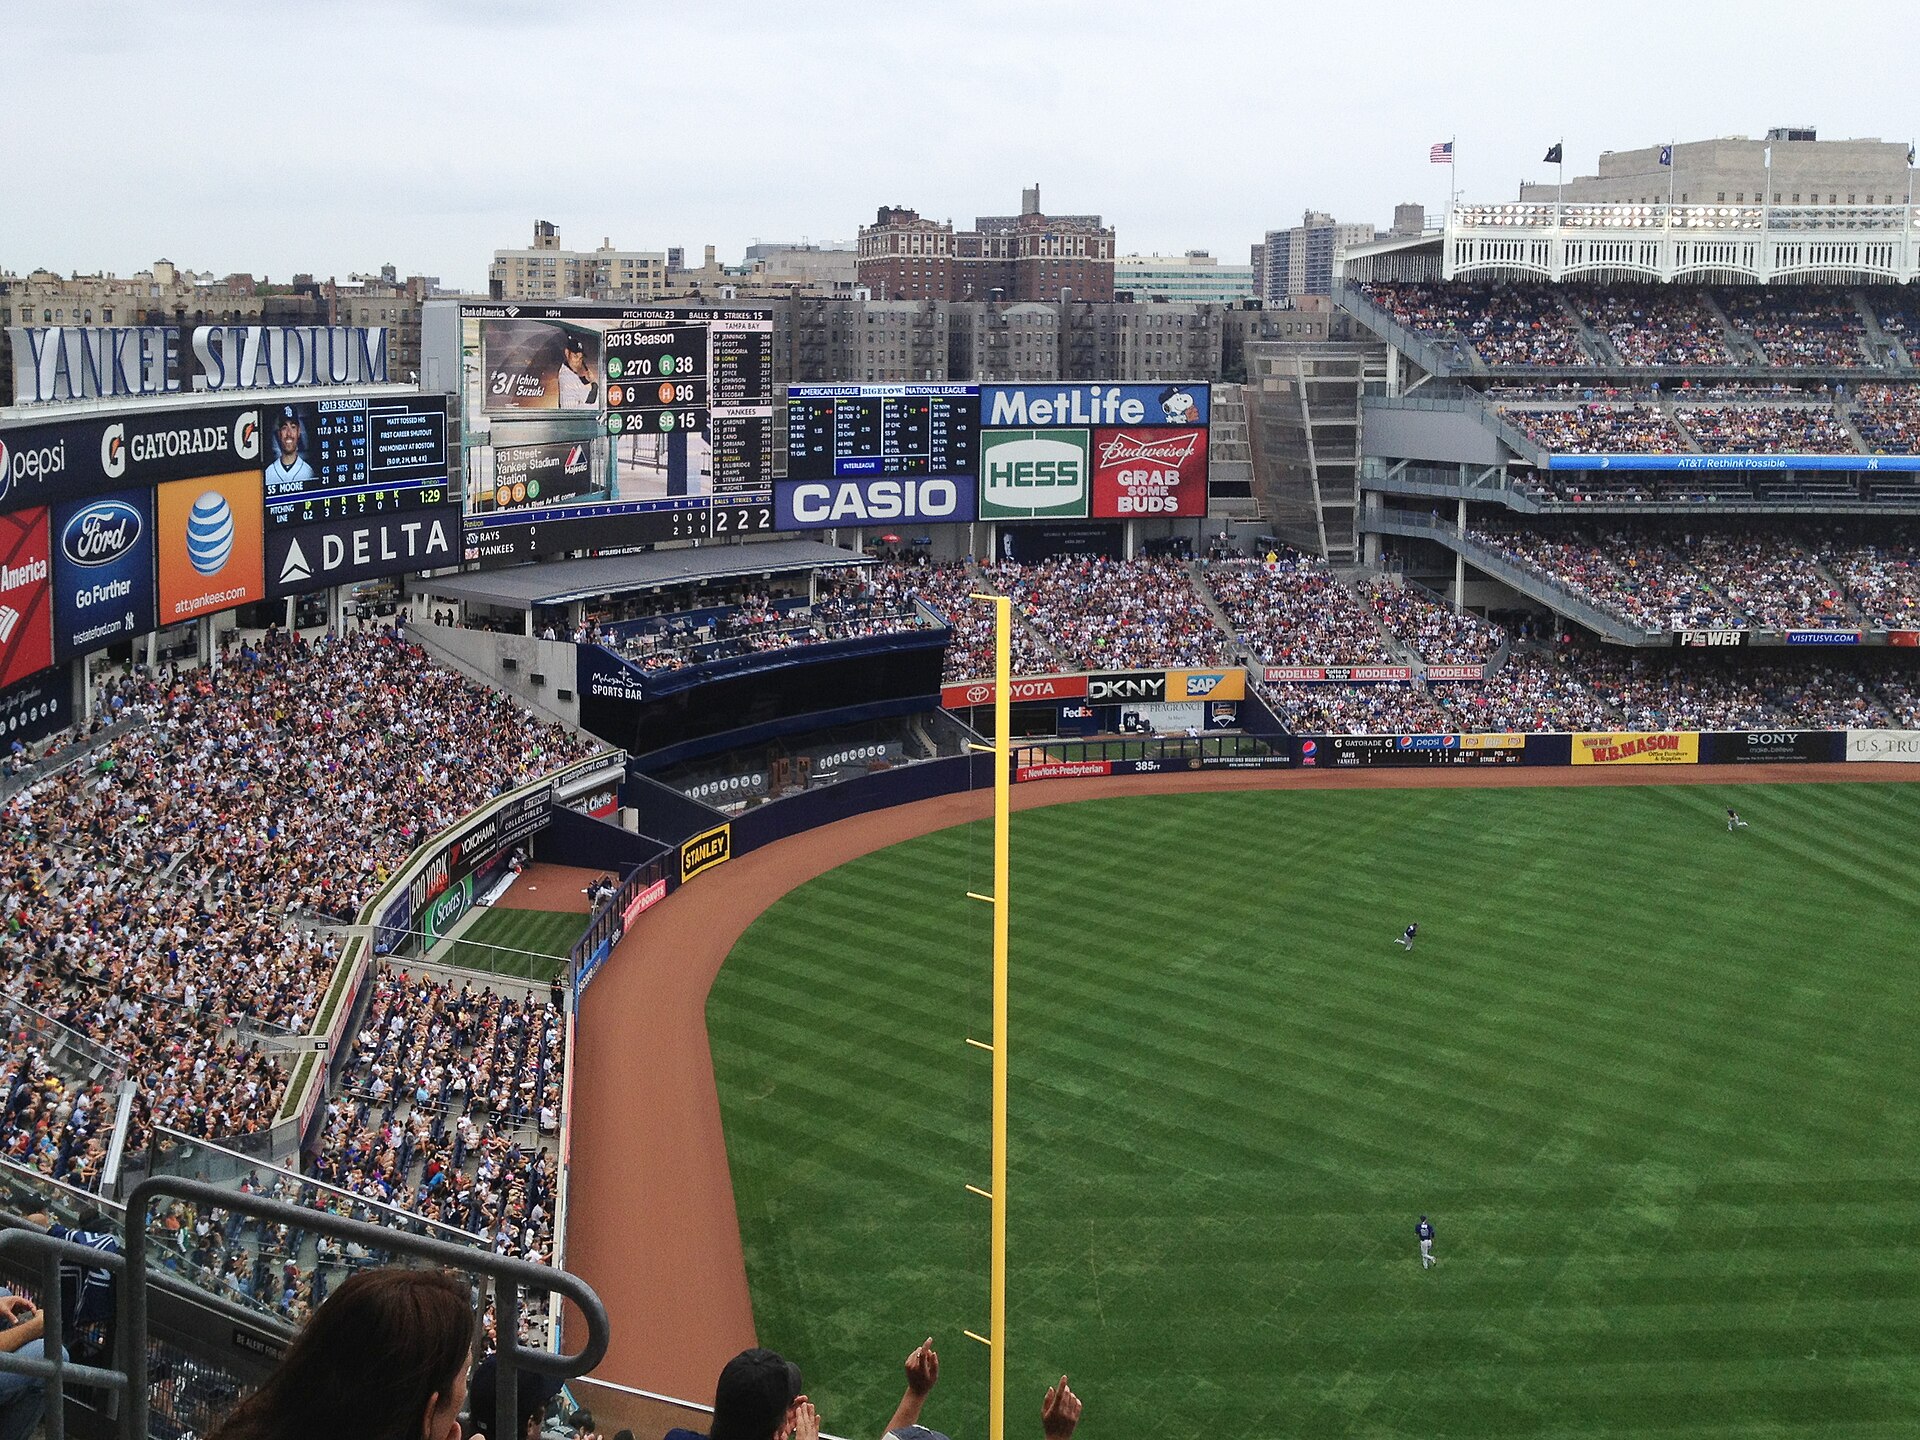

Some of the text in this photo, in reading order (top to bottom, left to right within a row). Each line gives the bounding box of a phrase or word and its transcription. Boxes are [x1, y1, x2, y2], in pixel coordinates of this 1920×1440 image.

[461, 307, 506, 317] Bank of America
[753, 312, 763, 320] 15
[607, 331, 675, 348] 2013 Season
[22, 326, 389, 402] YANKEE STADIUM
[623, 356, 693, 376] .270 38
[516, 374, 540, 386] Ichiro
[516, 385, 545, 397] Suzuki
[626, 385, 694, 402] 6 96
[321, 400, 363, 411] 2013 SEASON
[990, 386, 1144, 424] MetLife
[626, 412, 696, 430] 26 15
[131, 425, 228, 462] GATORADE
[1100, 442, 1194, 460] Budweiser
[13, 439, 65, 487] pepsi
[496, 450, 542, 463] 161 Street-
[1678, 459, 1788, 468] AT&T. Rethink Possible.
[496, 457, 560, 475] Yankee Stadium
[990, 461, 1078, 488] HESS
[496, 473, 527, 487] Station
[1118, 470, 1180, 486] GRAB
[279, 482, 304, 493] MOORE
[420, 489, 440, 503] 1:29
[1128, 486, 1168, 496] SOME
[270, 504, 294, 515] PITCHING
[792, 480, 957, 522] CASIO
[1118, 497, 1178, 512] BUDS
[276, 514, 288, 524] LINE
[480, 513, 692, 542] RAYS 0 0 0
[716, 508, 770, 531] 2 2 2
[78, 511, 127, 558] Ford
[322, 519, 449, 571] DELTA
[480, 544, 514, 556] YANKEES
[622, 547, 641, 555] ELECTRIC
[1, 557, 48, 592] America
[76, 580, 132, 609] Go Further
[175, 585, 246, 615] att.yankees.com
[73, 620, 122, 646] tristateford.com
[1792, 634, 1854, 642] VISITUSVI.COM
[1269, 669, 1320, 679] MODELL'S
[1355, 669, 1406, 678] MODELL'S
[1429, 668, 1481, 678] MODELL'S
[626, 678, 642, 688] Sun
[992, 682, 1054, 699] YOTA
[1088, 678, 1165, 699] DKNY
[1187, 678, 1218, 693] SAP
[592, 684, 642, 700] SPORTS BAR
[1063, 706, 1092, 718] FedEx
[1150, 704, 1202, 712] FRAGRANCE
[1747, 734, 1798, 744] SONY
[1856, 740, 1881, 752] U.S.
[590, 792, 611, 810] Chews
[504, 806, 543, 831] COLLECTIBLES
[461, 822, 496, 855] YOKOHAMA
[499, 816, 550, 848] STEINERSPORTS.COM
[685, 836, 724, 869] STANLEY
[411, 874, 426, 915] ZOO
[426, 853, 449, 898] YORK
[642, 885, 665, 905] DONUTS
[436, 892, 461, 926] Scotts
[246, 1338, 265, 1352] ALERT
